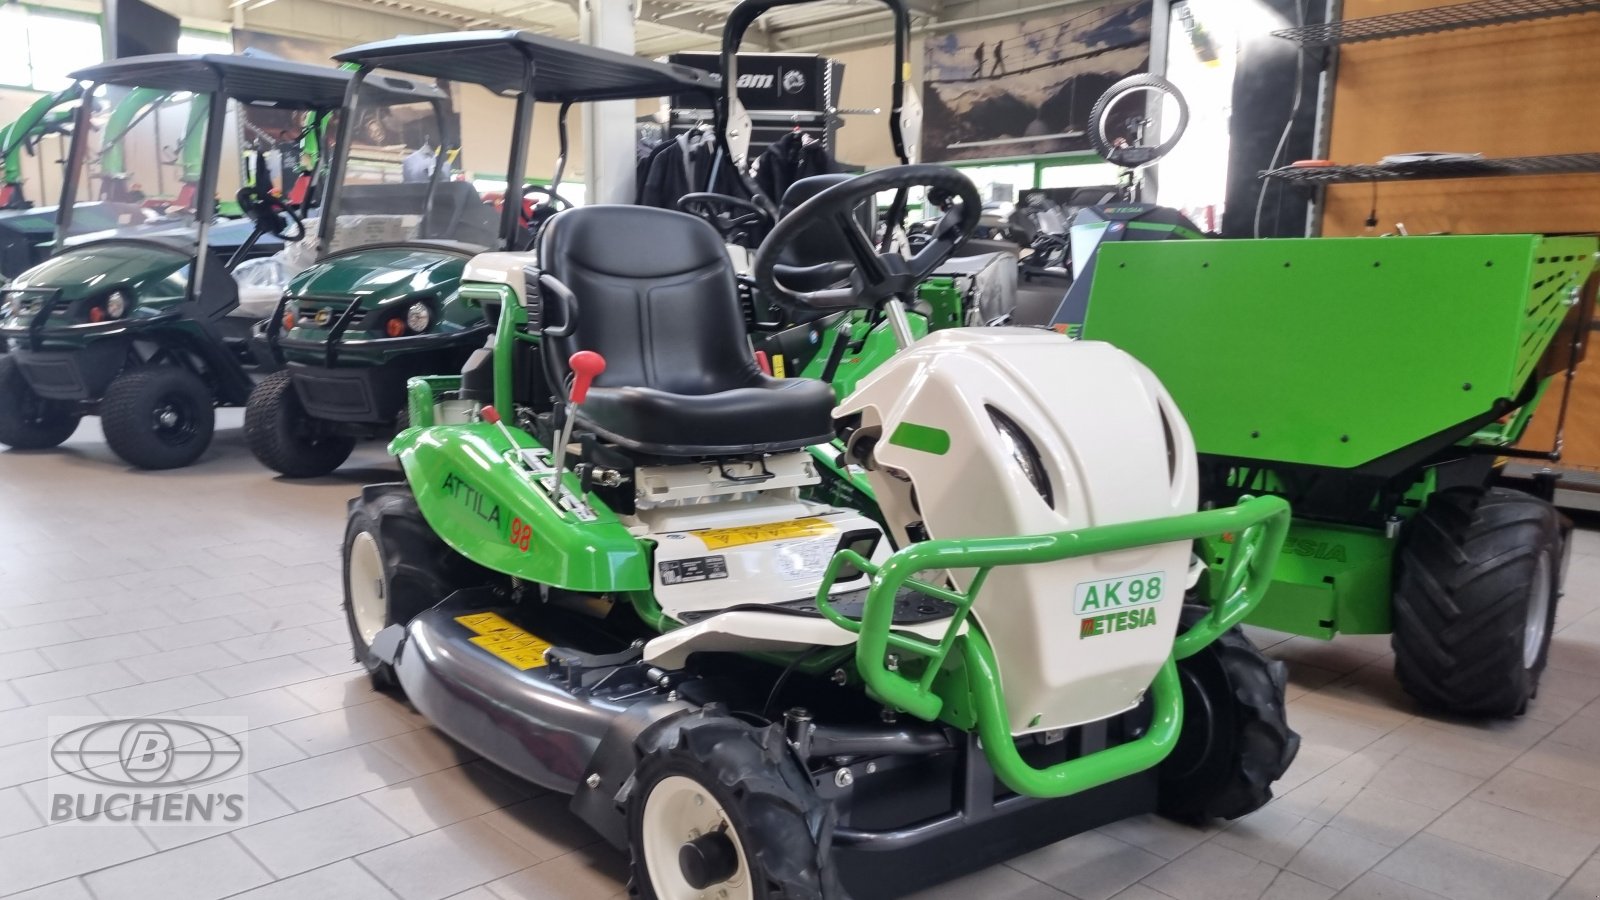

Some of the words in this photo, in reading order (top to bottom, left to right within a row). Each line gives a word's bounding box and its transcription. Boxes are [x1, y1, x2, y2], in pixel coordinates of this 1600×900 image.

[442, 472, 501, 531] ATTILA
[510, 517, 532, 553] 98
[1080, 581, 1123, 612] AK
[1128, 576, 1162, 603] 98
